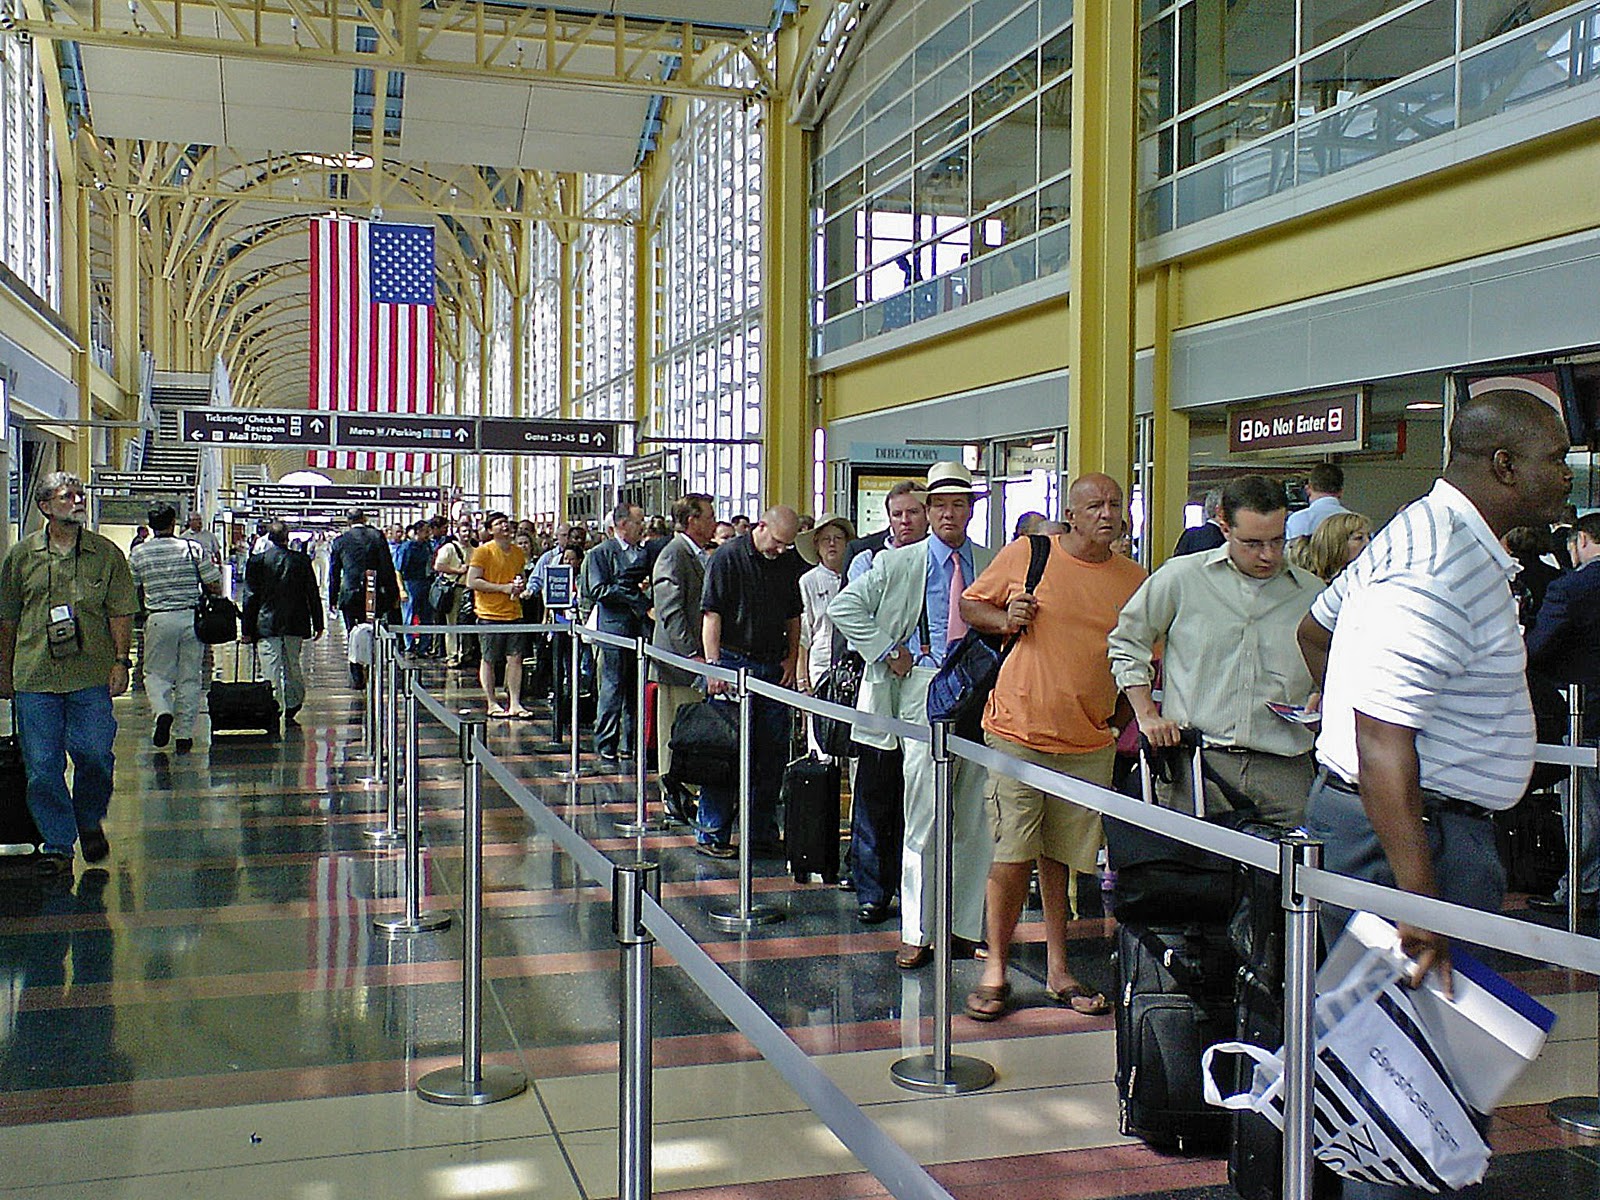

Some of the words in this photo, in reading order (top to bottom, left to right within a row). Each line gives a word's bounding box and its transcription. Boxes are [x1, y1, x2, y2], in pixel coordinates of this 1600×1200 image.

[205, 413, 274, 425] Ticketing/Check
[276, 416, 286, 424] In
[244, 424, 286, 433] Restroom
[349, 427, 375, 436] Metro
[1254, 420, 1270, 438] Do
[1273, 417, 1294, 437] Not
[1297, 414, 1326, 433] Enter
[228, 431, 249, 441] Mail
[251, 432, 273, 442] Drop
[524, 432, 549, 441] Gates
[875, 448, 939, 460] DIRECTORY
